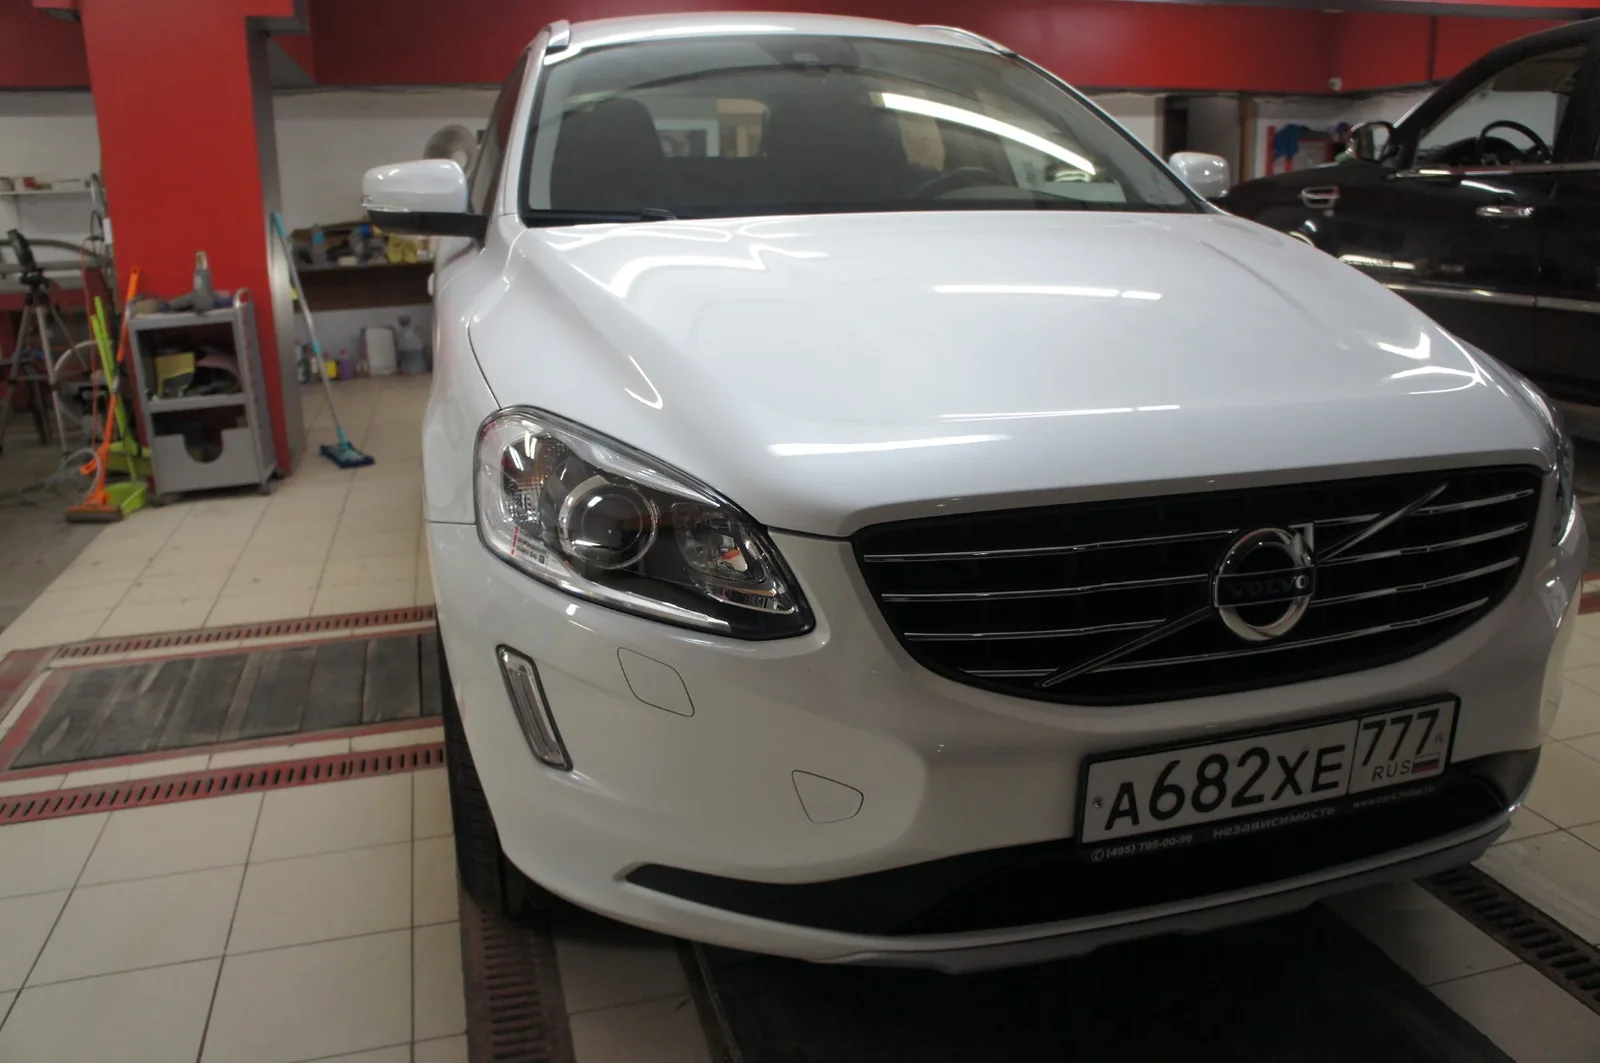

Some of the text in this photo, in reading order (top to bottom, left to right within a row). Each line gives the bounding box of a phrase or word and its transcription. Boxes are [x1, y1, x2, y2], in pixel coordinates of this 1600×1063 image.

[1225, 574, 1310, 598] VOLVO
[1362, 709, 1440, 766] 777
[1372, 760, 1411, 782] RUS
[1212, 806, 1336, 839] независимость
